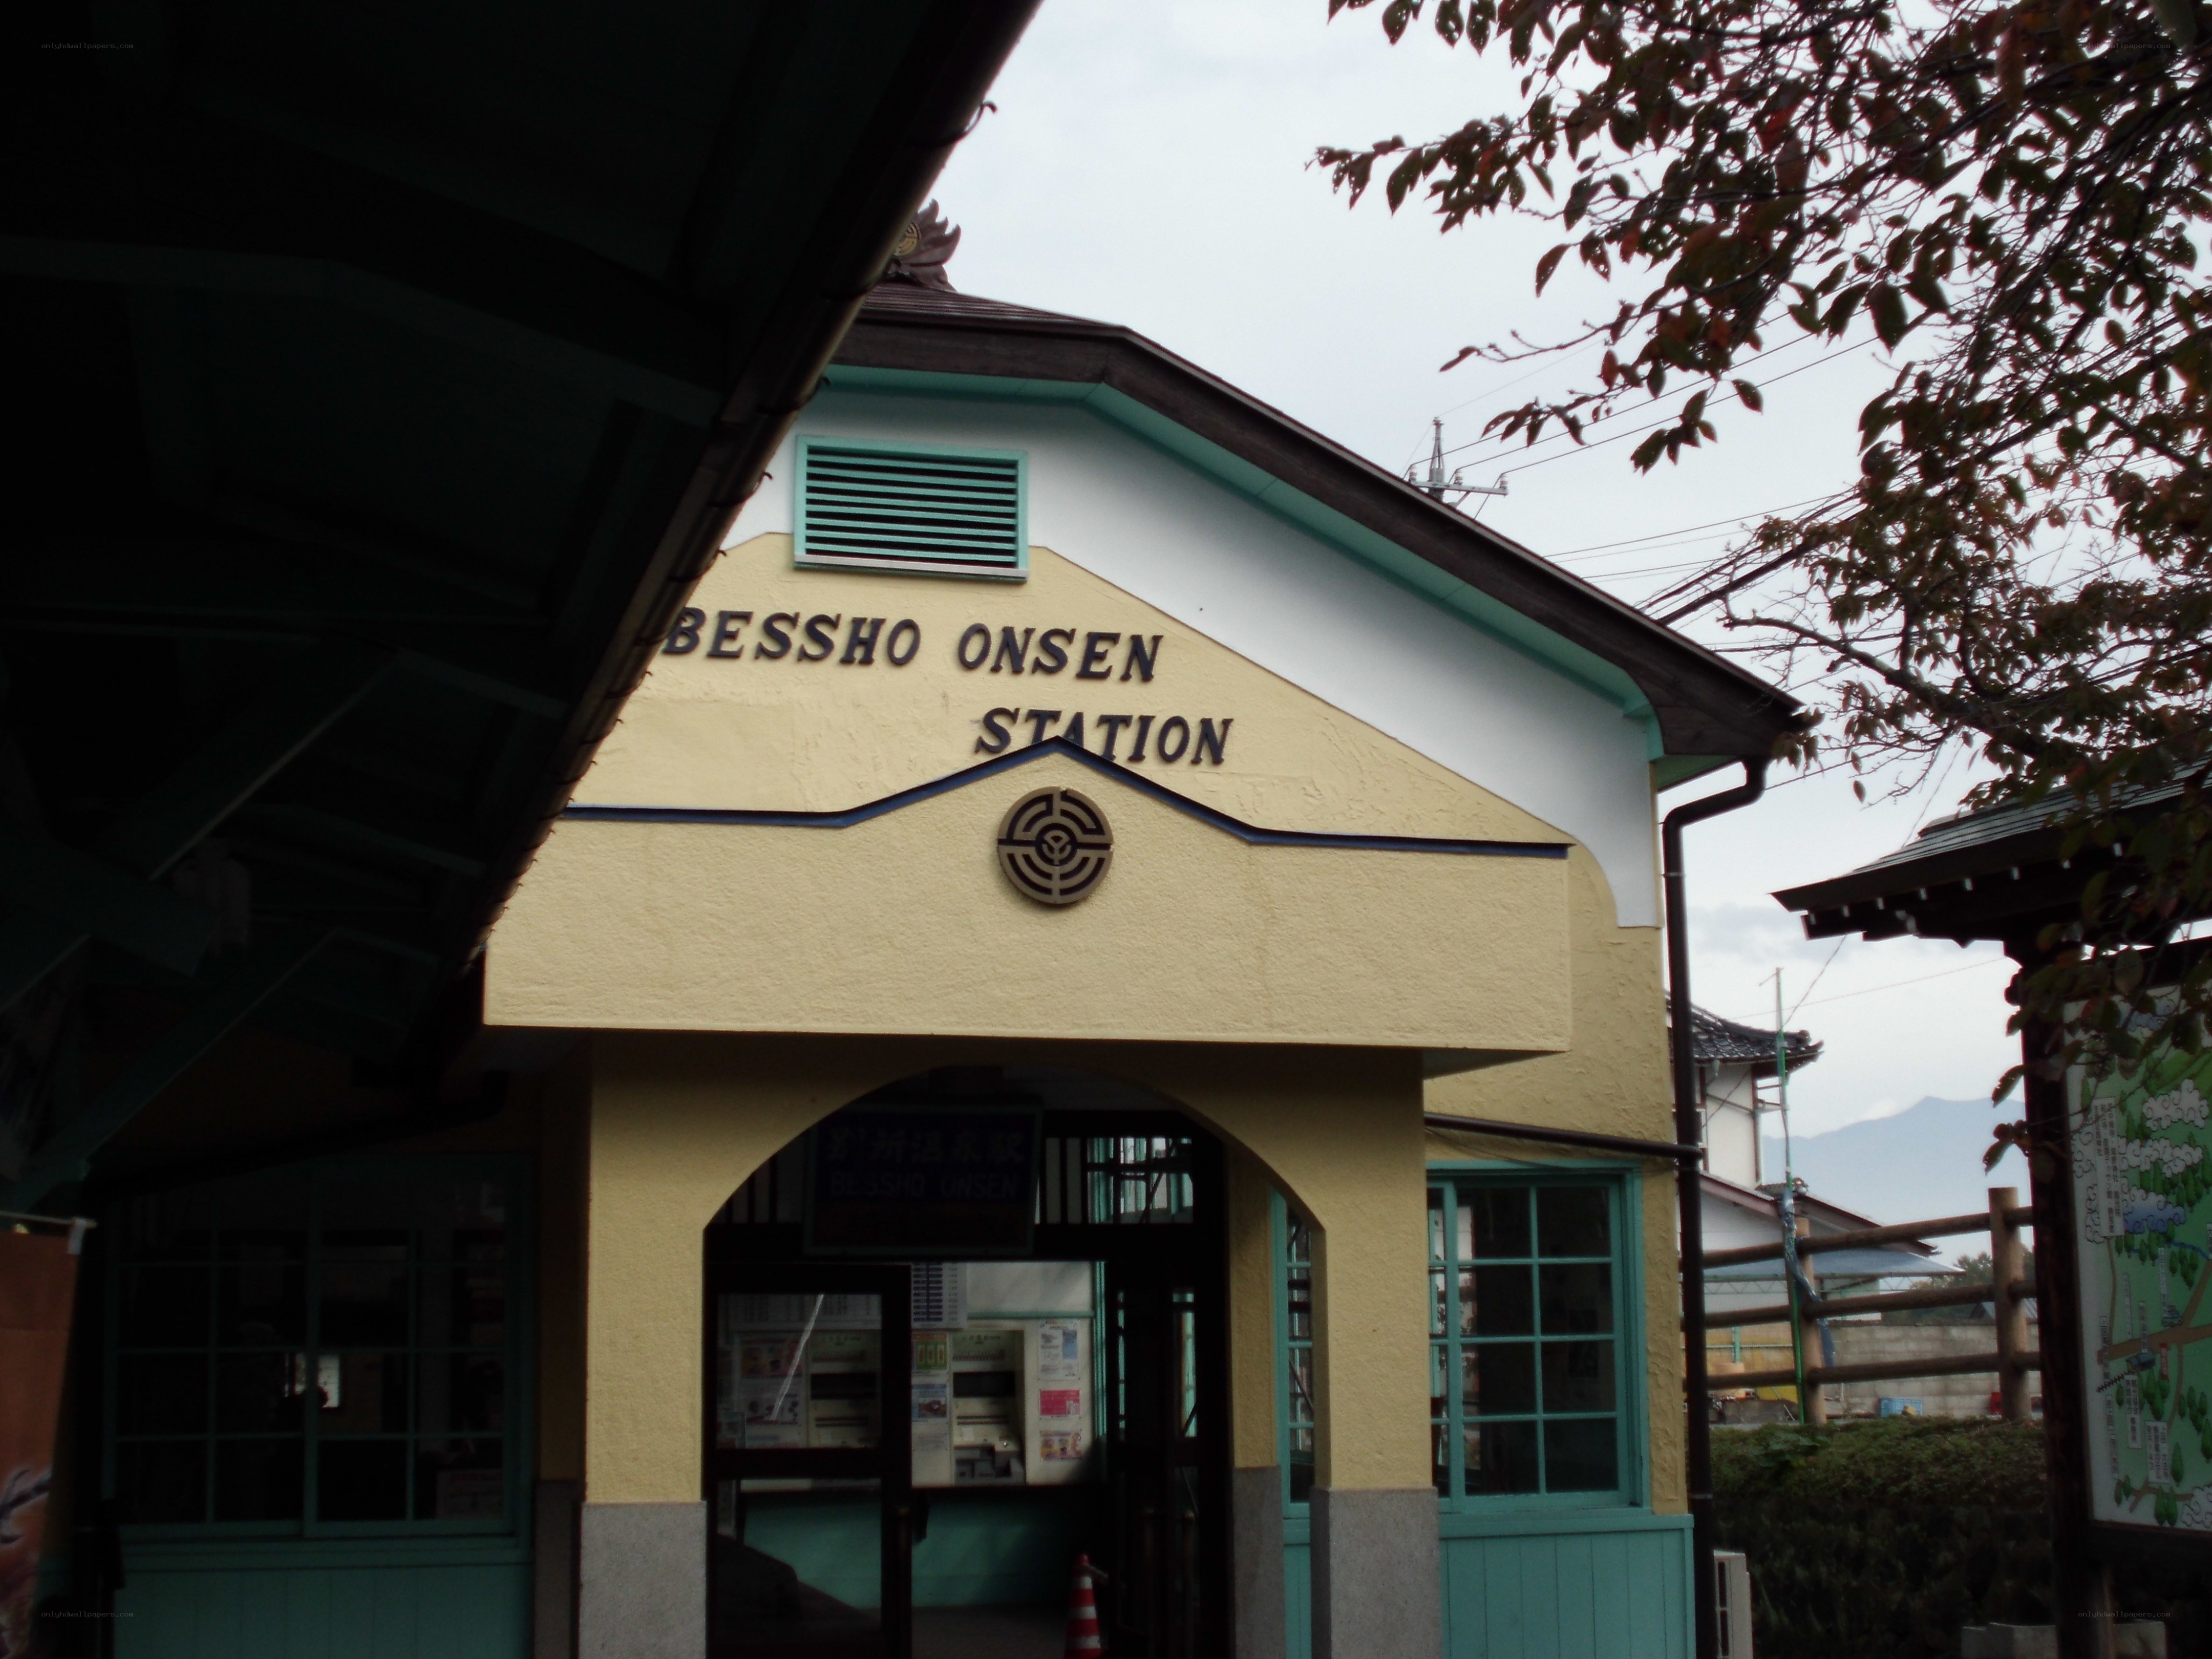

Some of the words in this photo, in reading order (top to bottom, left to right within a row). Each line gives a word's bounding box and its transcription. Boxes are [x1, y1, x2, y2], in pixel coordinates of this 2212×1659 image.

[663, 607, 921, 666] BESSHO
[958, 623, 1163, 682] ONSEN
[827, 1127, 1024, 1164] 別所温泉駅
[830, 1171, 925, 1197] BESSHO
[940, 1173, 1018, 1199] ONSEN
